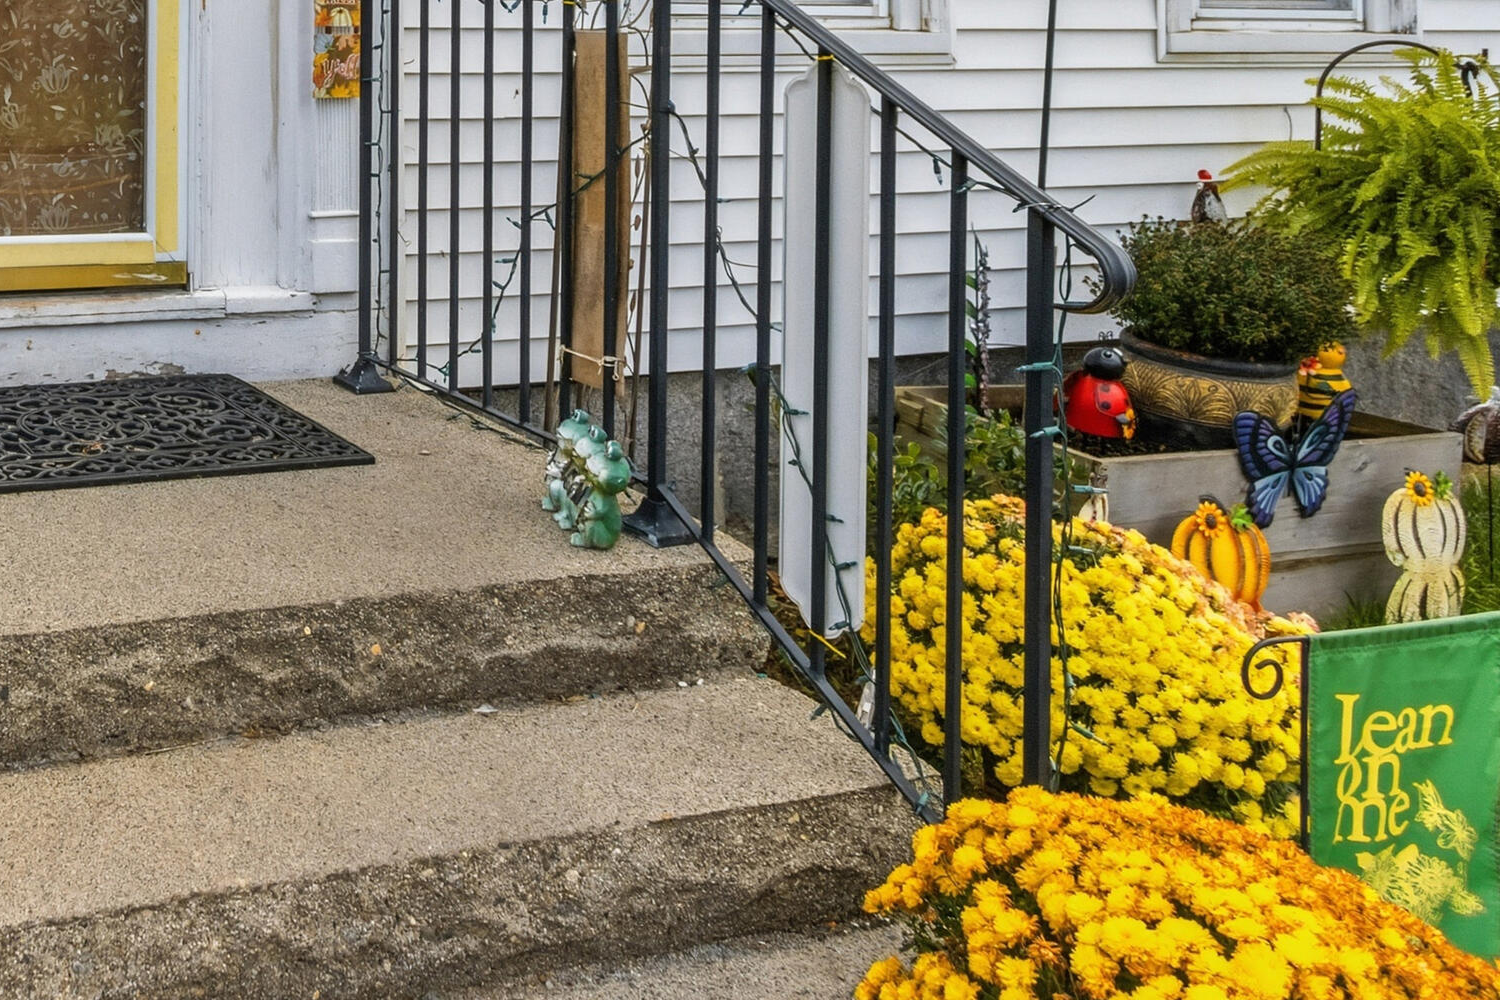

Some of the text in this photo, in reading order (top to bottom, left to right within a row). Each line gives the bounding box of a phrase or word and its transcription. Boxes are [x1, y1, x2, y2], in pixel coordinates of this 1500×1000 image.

[1334, 693, 1455, 764] Lean
[1335, 751, 1403, 803] on
[1332, 788, 1410, 844] me
